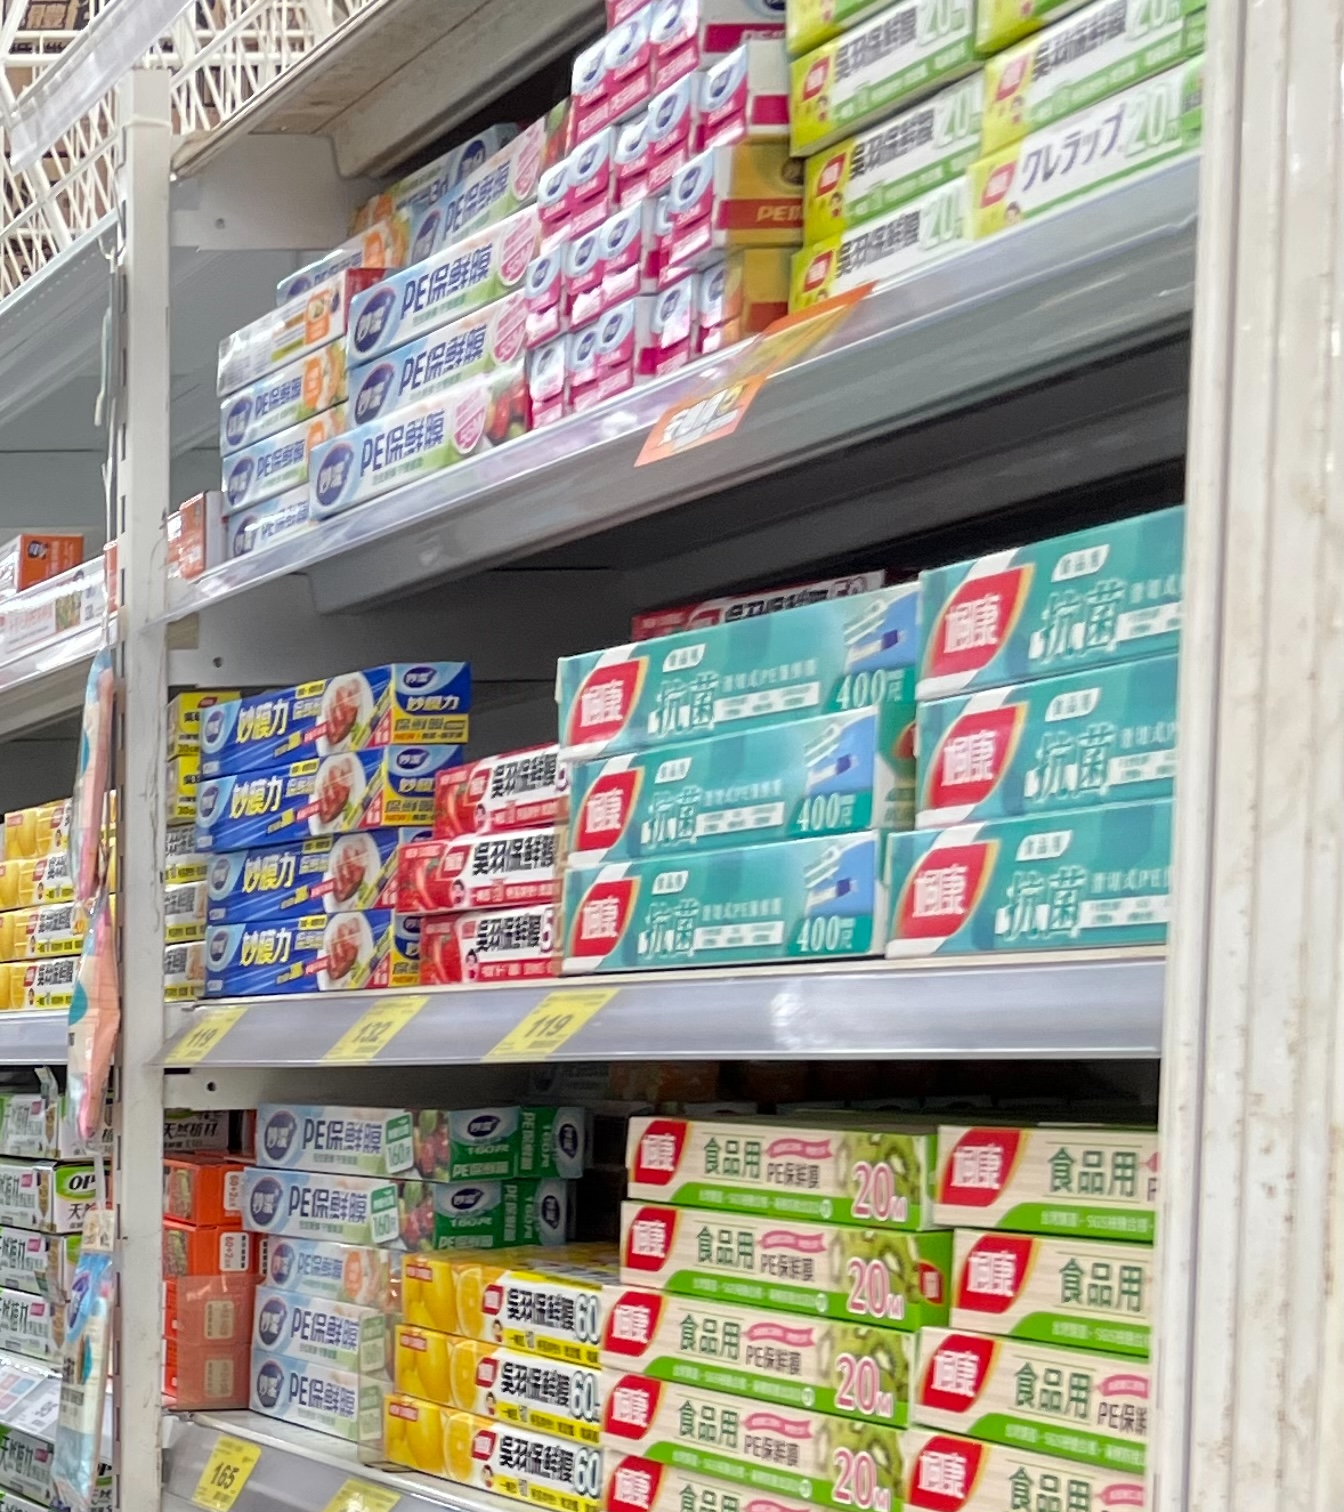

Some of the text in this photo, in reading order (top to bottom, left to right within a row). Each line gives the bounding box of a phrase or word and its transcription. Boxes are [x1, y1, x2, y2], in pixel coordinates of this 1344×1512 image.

[401, 243, 492, 320] PE保鮮膜
[398, 323, 487, 397] PE保鮮膜
[361, 408, 445, 476] PE保鮮膜
[1030, 578, 1124, 662] 抗菌
[236, 698, 289, 744] 妙膜力
[1025, 721, 1117, 799] 抗菌
[229, 773, 282, 819] 妙膜力
[242, 848, 295, 894] 妙膜力
[996, 864, 1089, 941] 抗菌
[239, 928, 291, 967] 妙膜力
[354, 1020, 392, 1043] 132
[525, 1013, 572, 1040] 119
[302, 1118, 382, 1155] PE保鮮膜
[704, 1137, 761, 1179] 食品用
[767, 1162, 820, 1189] PE保鮮膜
[1048, 1147, 1137, 1197] 食品用
[288, 1186, 368, 1223] PE保鮮膜
[696, 1226, 755, 1270] 食品用
[761, 1254, 815, 1282] PE保鮮膜
[1059, 1258, 1142, 1312] 食品用
[291, 1308, 359, 1350] PE保鮮膜
[680, 1314, 741, 1361] 食品用
[745, 1345, 802, 1376] PE保鮮膜
[288, 1372, 355, 1417] PE保鮮膜
[1015, 1362, 1092, 1419] 食品用
[678, 1400, 740, 1449] 食品用
[744, 1434, 800, 1467] PE保鮮膜
[211, 1461, 238, 1489] 165
